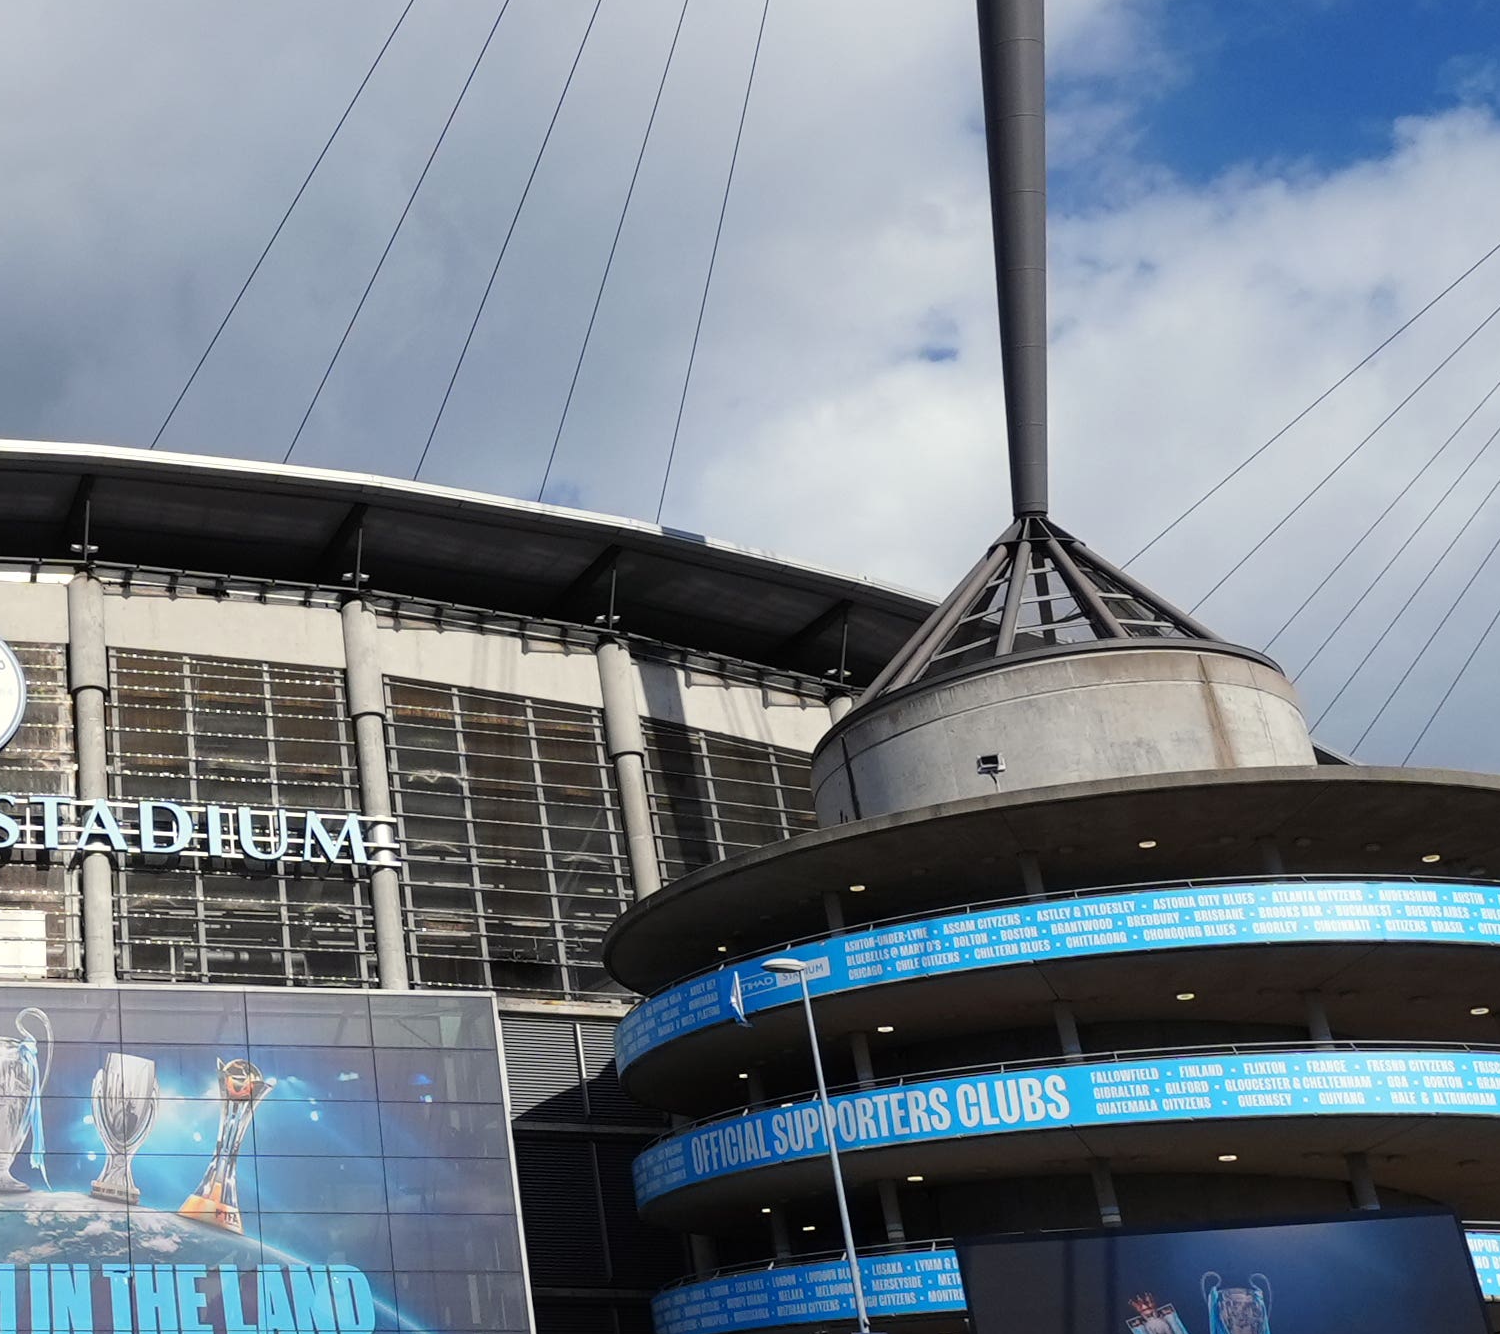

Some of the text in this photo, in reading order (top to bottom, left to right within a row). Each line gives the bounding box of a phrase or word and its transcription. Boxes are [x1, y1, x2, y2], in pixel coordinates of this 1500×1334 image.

[1153, 895, 1196, 910] ASTORIA
[1000, 926, 1038, 942] BOSTON
[1090, 1064, 1223, 1084] FALLOWFIELD FINLAND
[1093, 1076, 1292, 1099] GIBRALTAR GLOUCESTER
[690, 1117, 774, 1176] OFFICIAL
[773, 1090, 952, 1157] SUPPORTERS
[955, 1074, 1070, 1129] CLUBS
